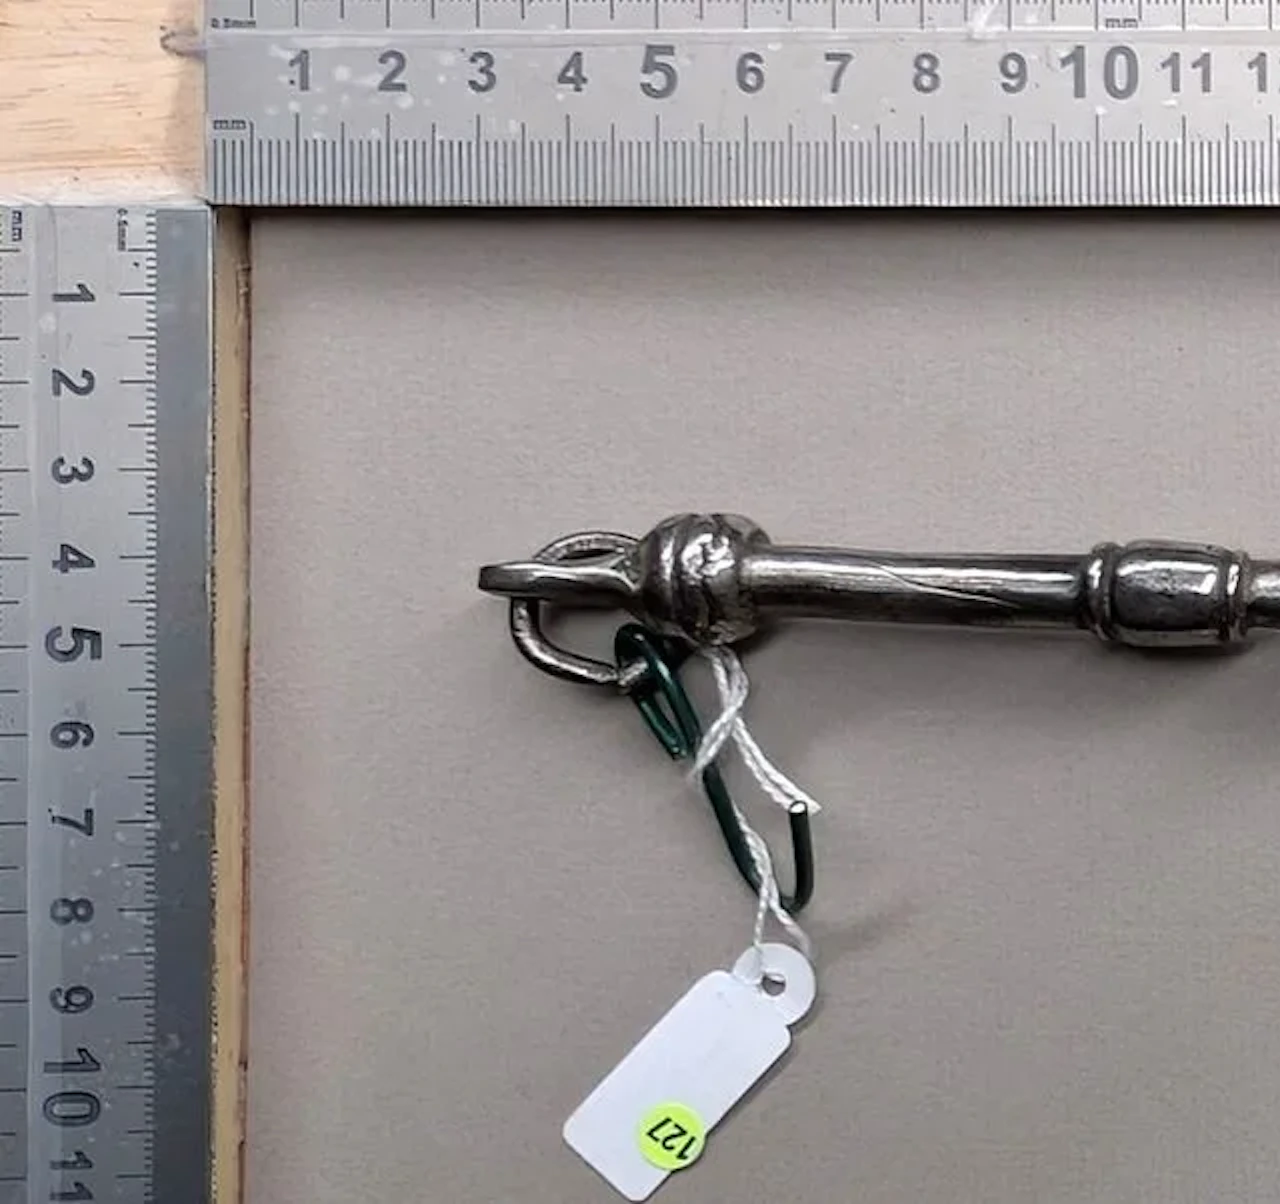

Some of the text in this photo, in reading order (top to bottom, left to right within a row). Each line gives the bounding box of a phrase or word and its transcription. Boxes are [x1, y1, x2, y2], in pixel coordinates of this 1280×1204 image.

[288, 48, 310, 92] 1
[377, 49, 408, 93] 2
[467, 50, 497, 94] 3
[556, 50, 589, 93] 4
[639, 43, 678, 100] 5
[735, 51, 766, 95] 6
[823, 51, 854, 94] 7
[911, 52, 941, 95] 8
[997, 51, 1029, 95] 9
[1059, 44, 1139, 101] 10
[1159, 51, 1212, 94] 11
[42, 282, 103, 1202] 1 2 3 4 5 6 7 8 9 10 11
[647, 1117, 697, 1160] 127
